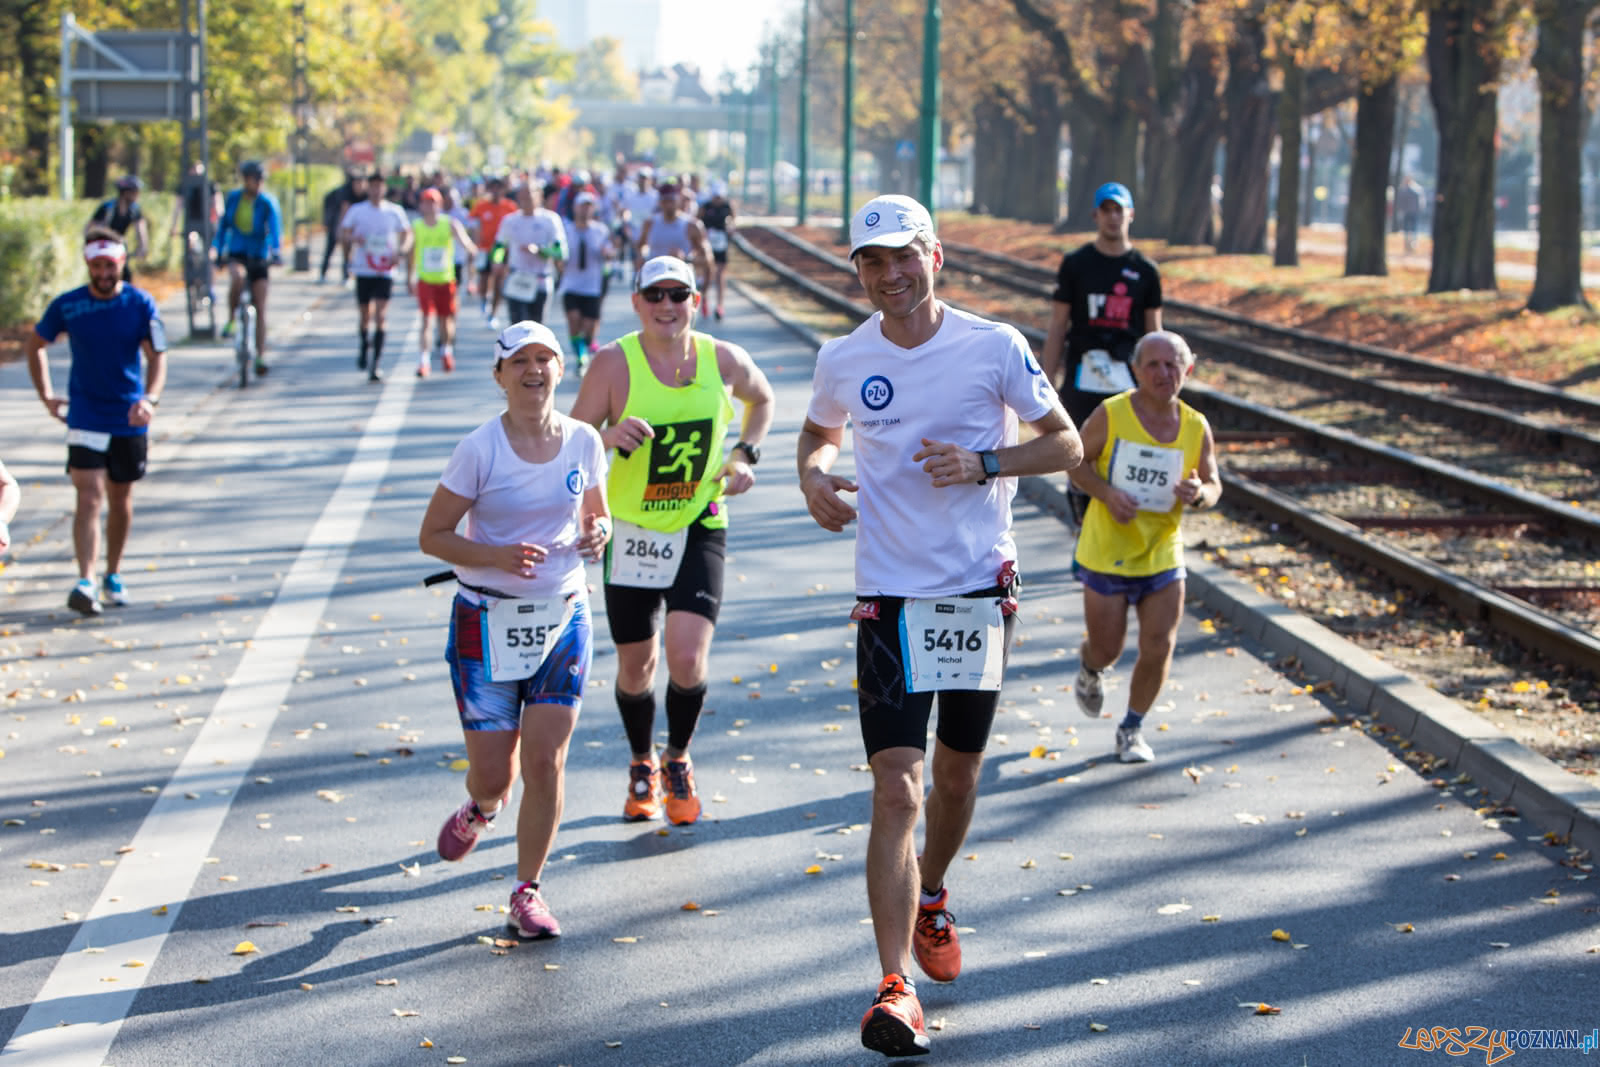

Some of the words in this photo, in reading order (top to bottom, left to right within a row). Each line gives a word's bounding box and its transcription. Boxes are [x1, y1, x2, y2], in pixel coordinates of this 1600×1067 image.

[867, 385, 887, 401] PZU
[860, 419, 880, 428] PORT
[881, 417, 901, 426] TEAM
[1125, 464, 1169, 487] 3875
[655, 483, 695, 499] night
[640, 498, 691, 512] runne
[624, 538, 674, 560] 2846
[506, 624, 558, 648] 535
[924, 628, 982, 652] 5416
